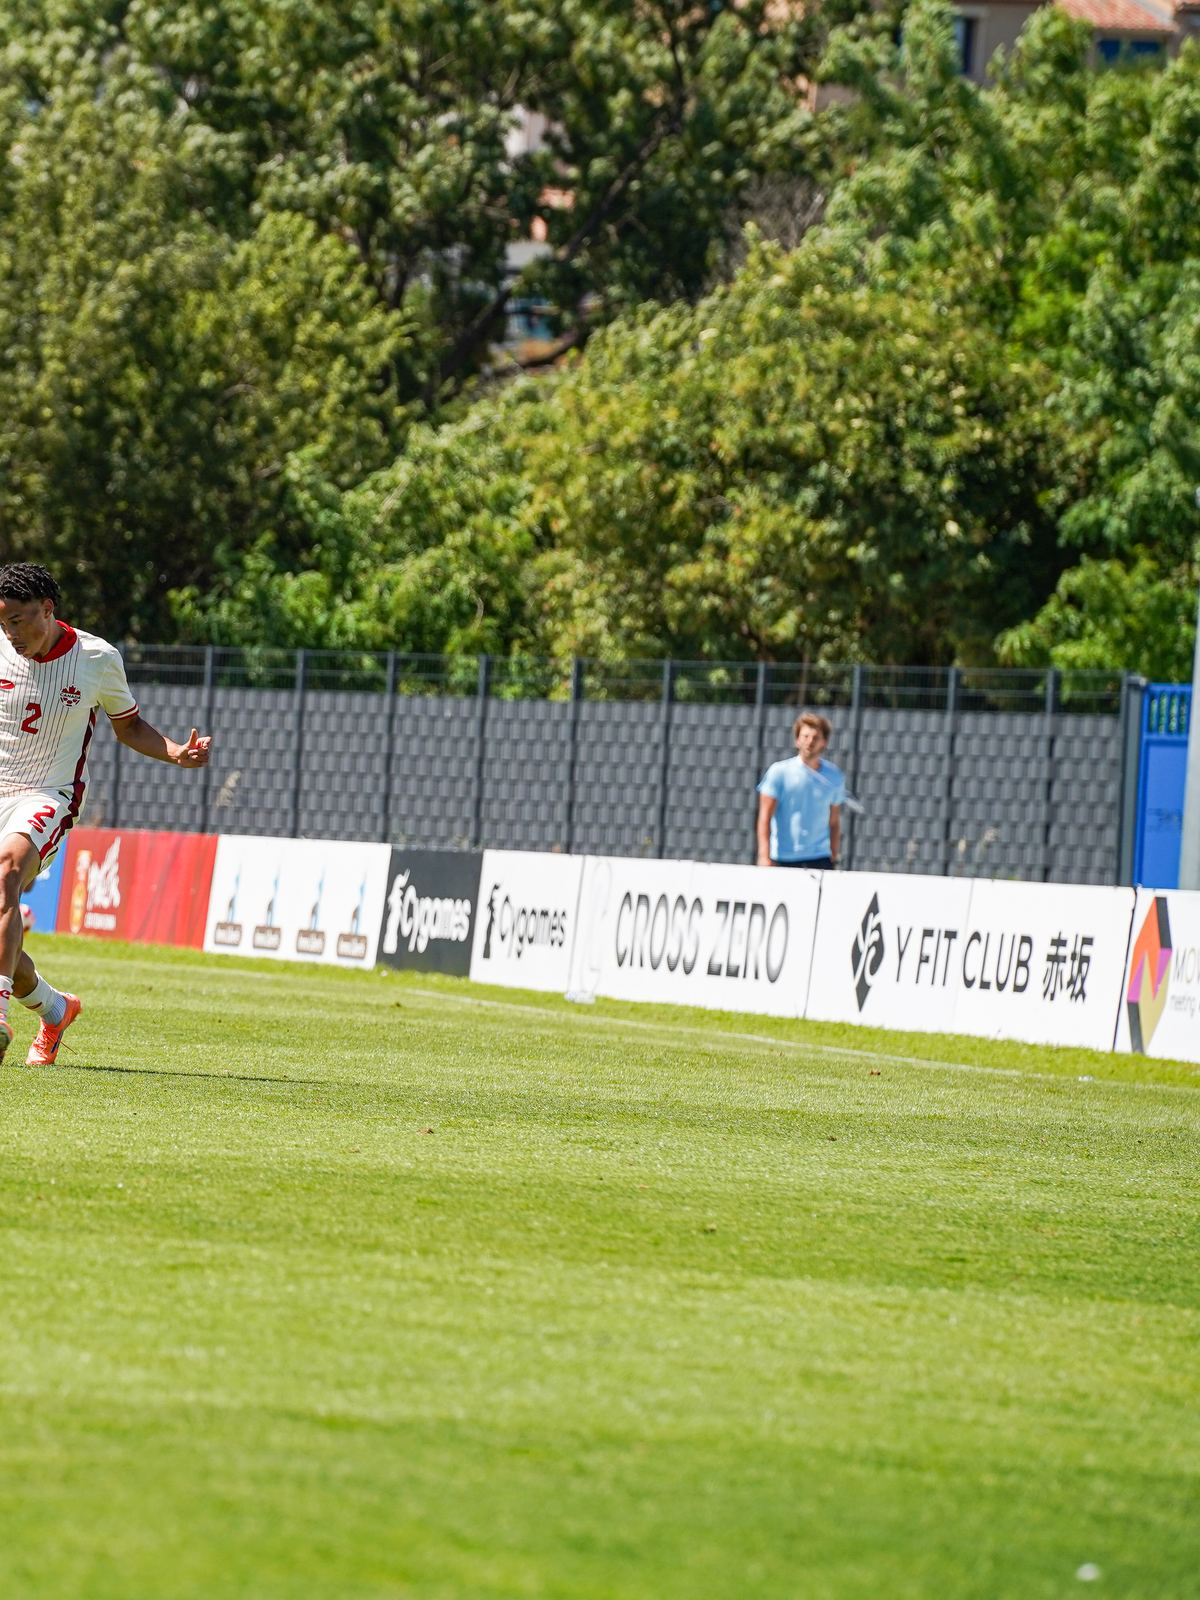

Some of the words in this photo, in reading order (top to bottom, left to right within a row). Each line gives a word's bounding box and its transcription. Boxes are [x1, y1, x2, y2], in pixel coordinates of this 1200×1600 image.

[21, 702, 42, 735] 2
[33, 804, 56, 827] 2
[401, 885, 472, 954] Cygames
[499, 894, 567, 959] Cygames
[615, 891, 704, 976] CROSS
[706, 900, 789, 984] ZERO
[896, 925, 913, 983] Y
[916, 928, 957, 987] FIT
[962, 930, 1034, 993] CLUB
[1043, 930, 1095, 1002] 赤坂
